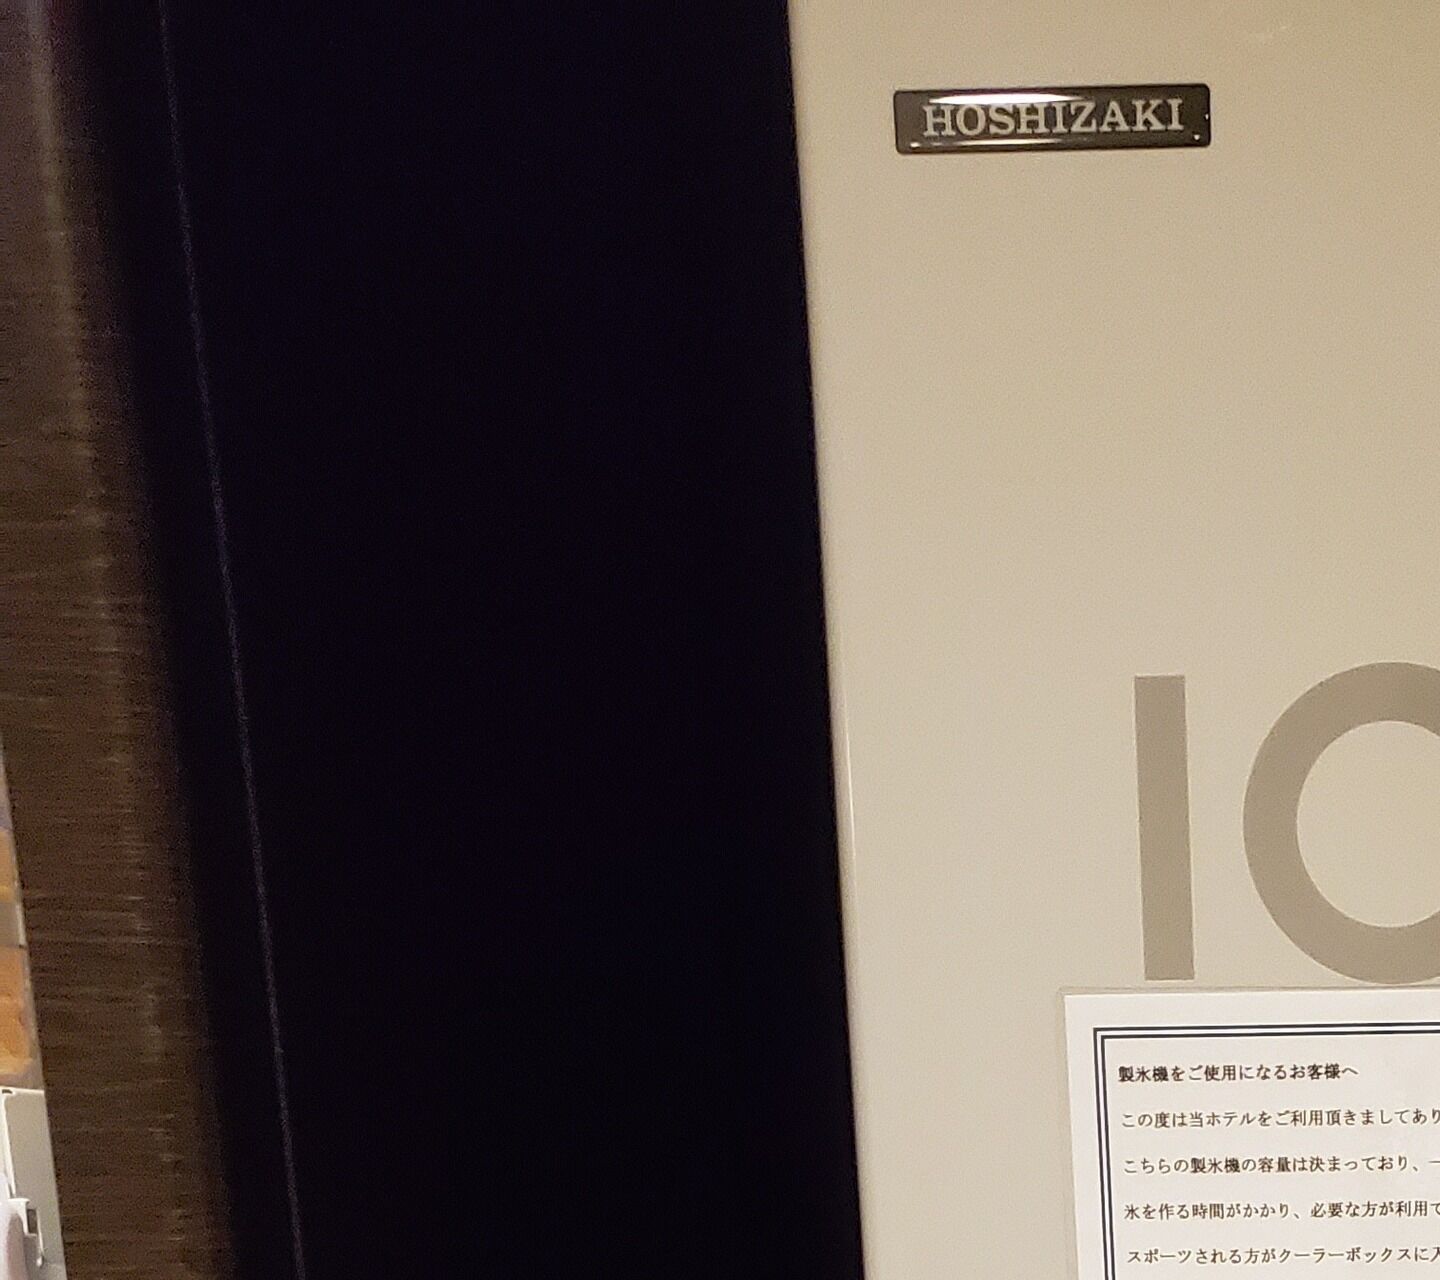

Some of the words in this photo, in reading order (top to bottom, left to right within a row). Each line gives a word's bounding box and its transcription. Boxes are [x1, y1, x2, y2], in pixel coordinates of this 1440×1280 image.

[922, 99, 1184, 137] HOSHIZAKI
[1118, 1063, 1359, 1083] 製氷機をご使用になるお客様へ
